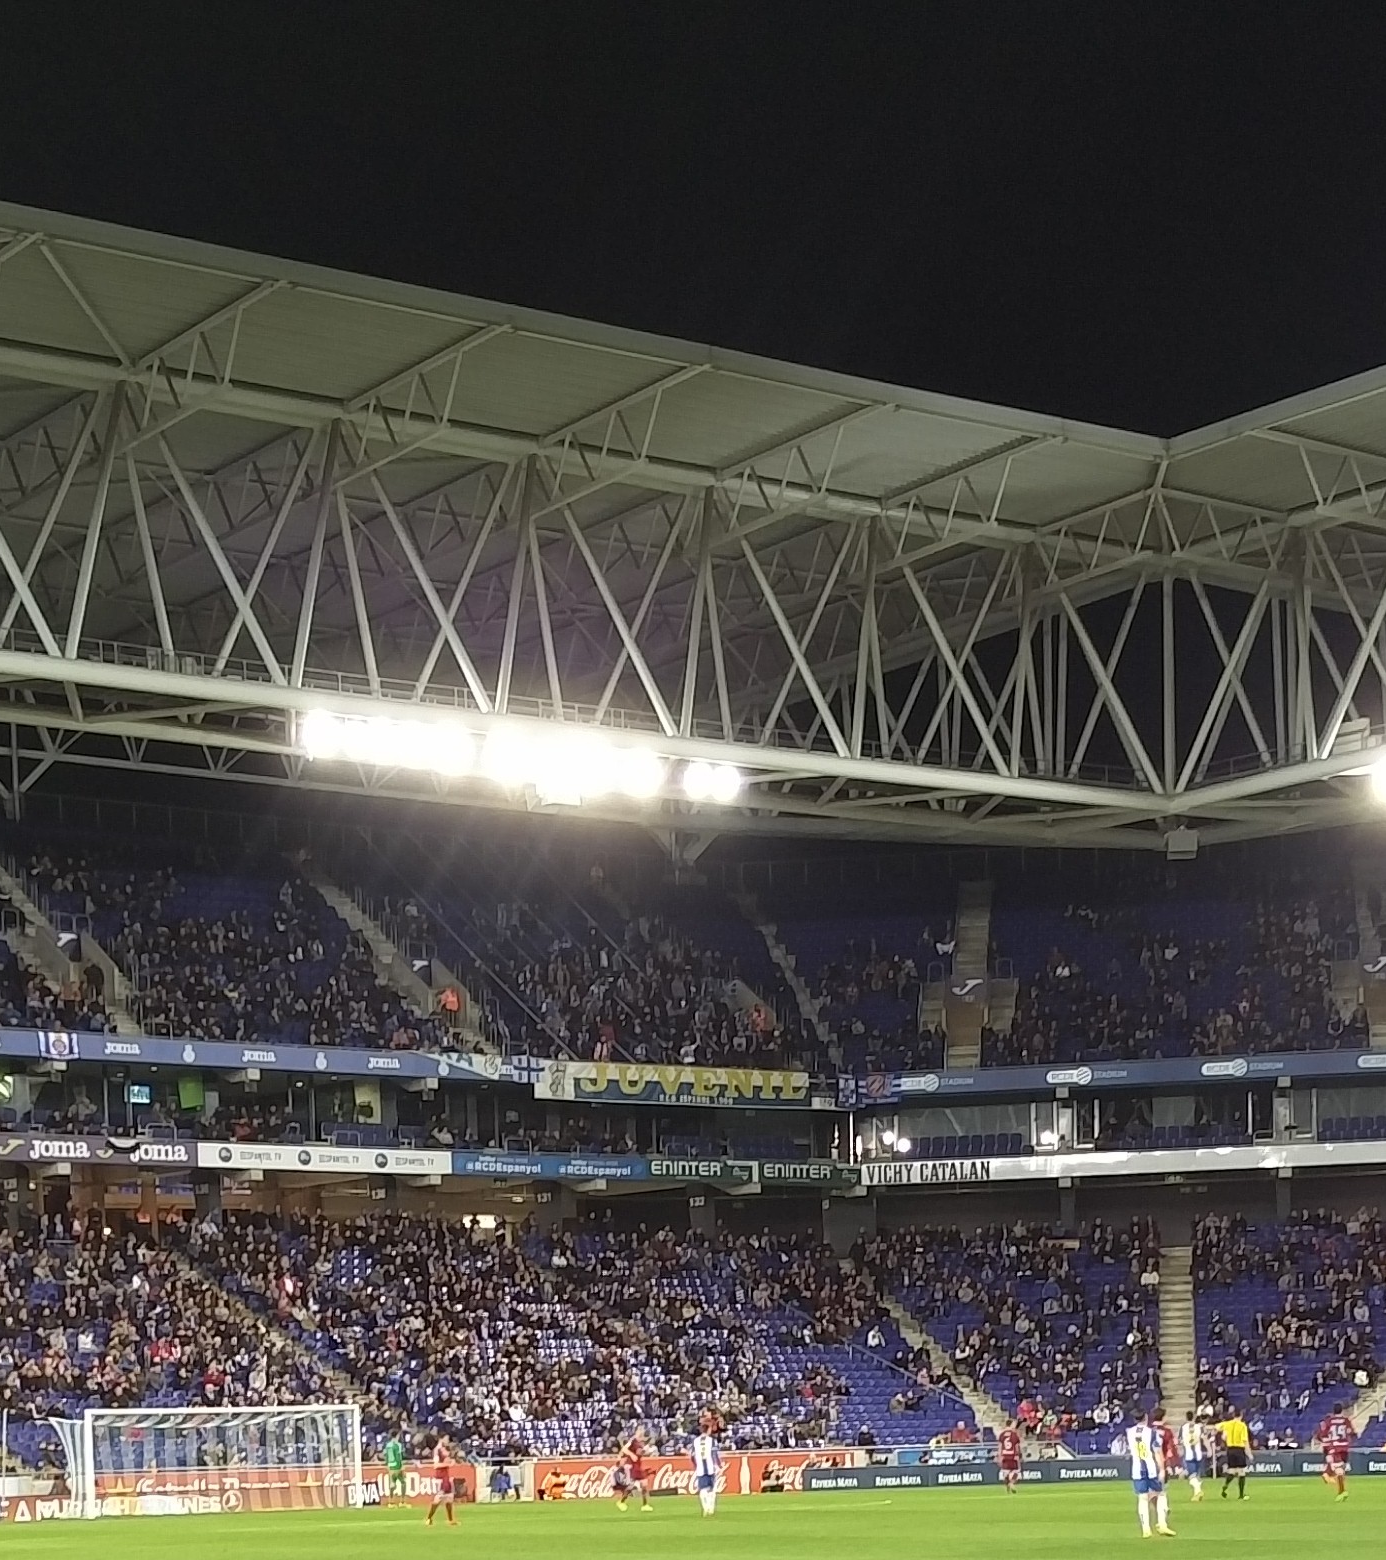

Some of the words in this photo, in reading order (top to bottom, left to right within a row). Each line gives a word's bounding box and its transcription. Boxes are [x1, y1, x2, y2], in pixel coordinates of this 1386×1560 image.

[579, 1062, 810, 1100] JUVENIL
[866, 1162, 914, 1184] VICHY
[919, 1160, 991, 1182] CATALAN
[1060, 1467, 1092, 1479] RIVIERA
[1093, 1467, 1118, 1479] MAYA
